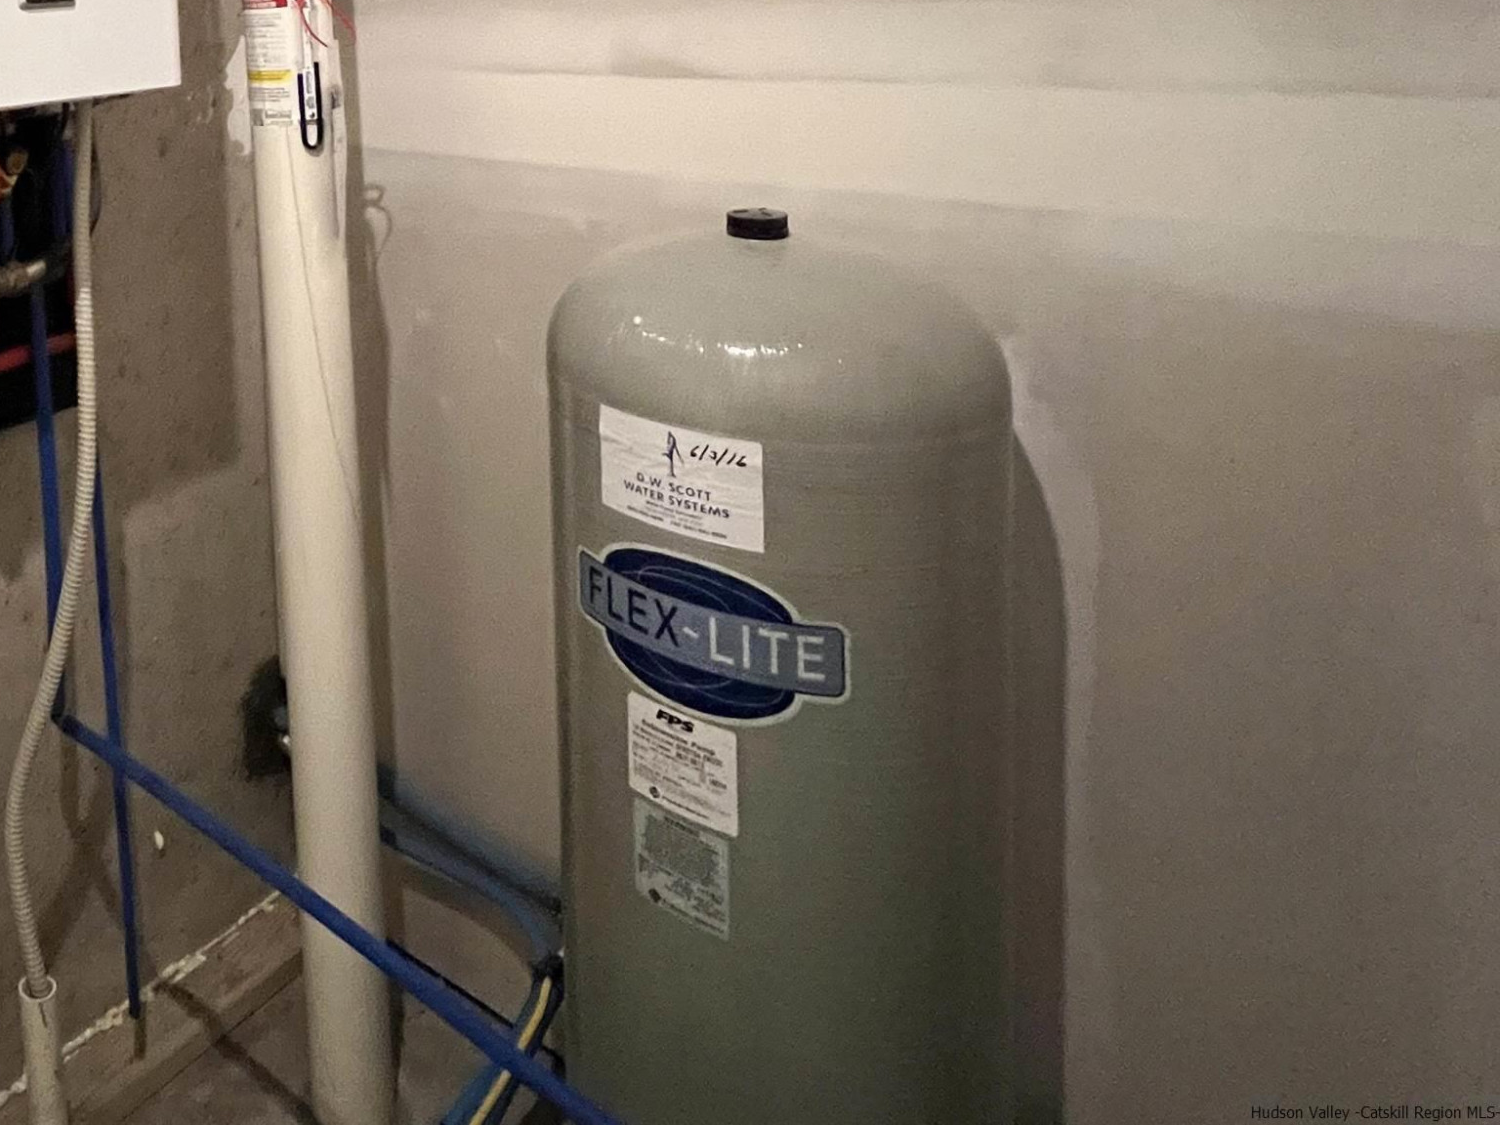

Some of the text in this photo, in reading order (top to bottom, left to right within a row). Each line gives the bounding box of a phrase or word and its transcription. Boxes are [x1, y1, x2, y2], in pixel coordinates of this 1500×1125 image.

[623, 480, 730, 519] WATER SYSTEMS
[668, 482, 711, 501] SCOTT
[588, 565, 827, 681] FLEX-LITE
[656, 709, 695, 733] FPS
